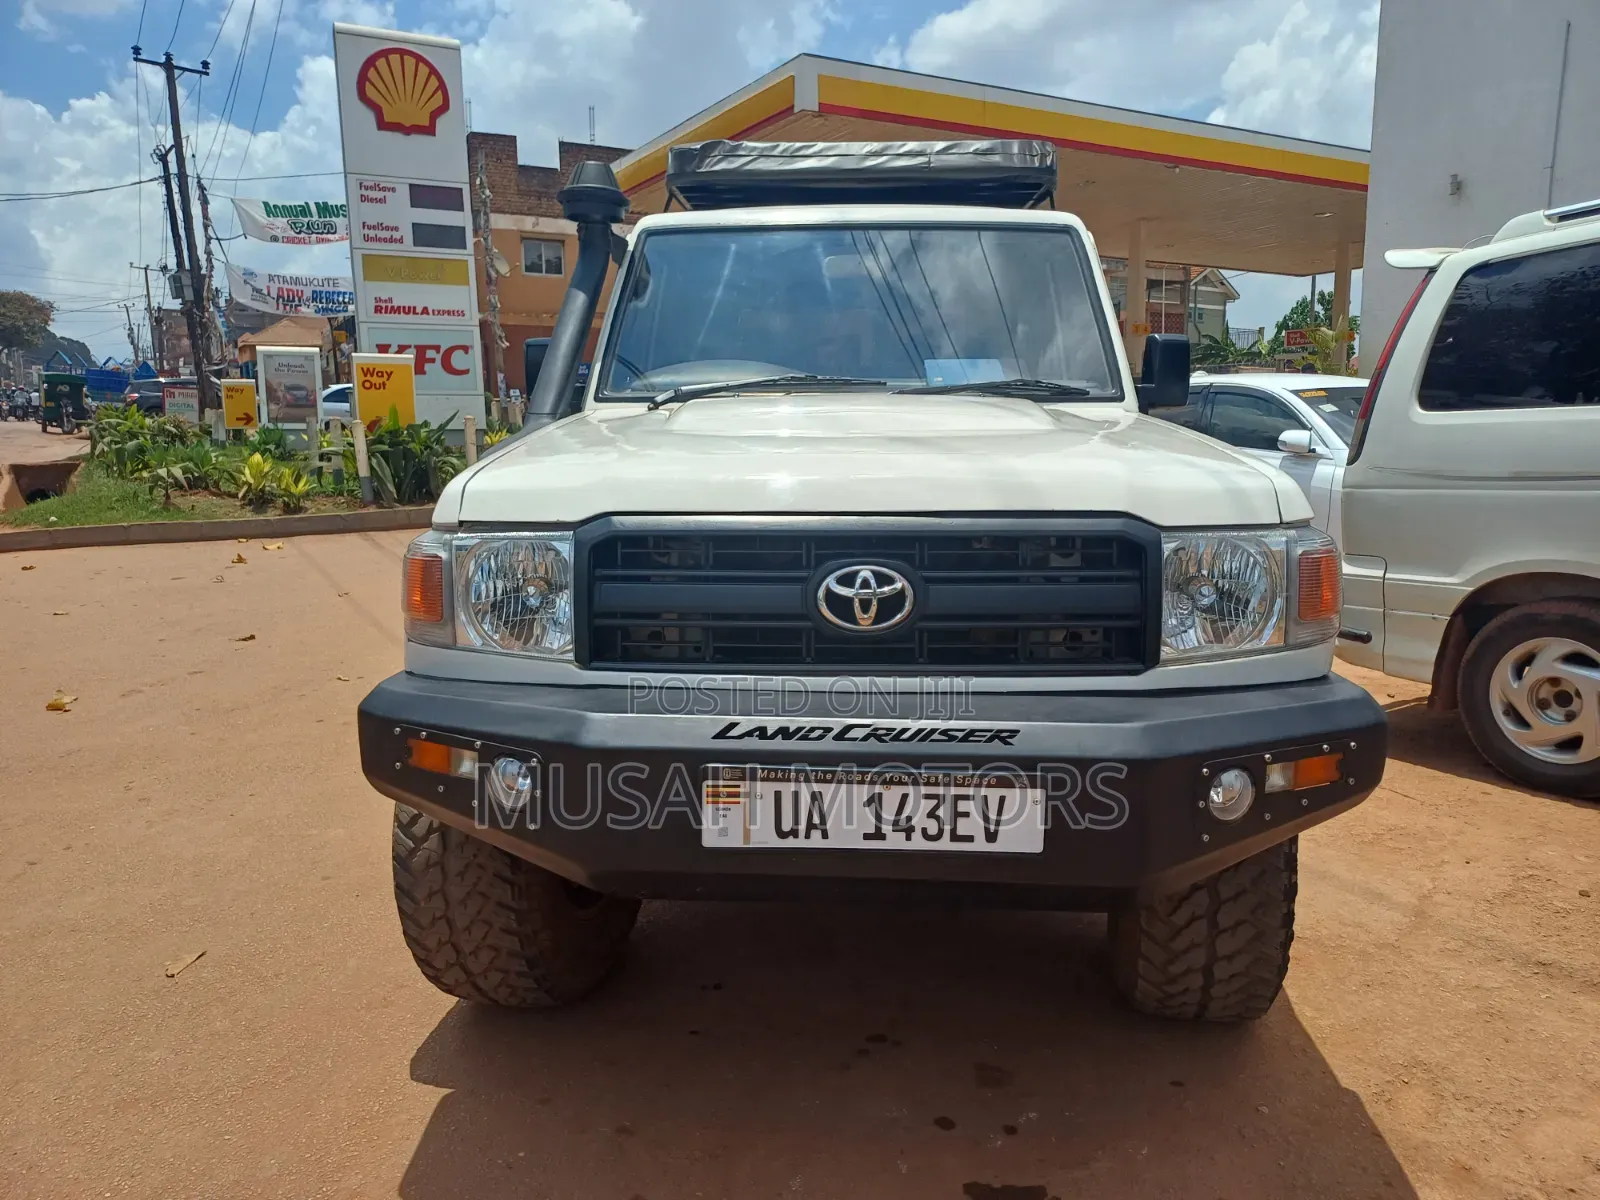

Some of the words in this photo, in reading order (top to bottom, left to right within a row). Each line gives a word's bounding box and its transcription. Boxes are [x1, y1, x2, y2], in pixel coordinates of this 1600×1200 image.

[359, 182, 396, 193] FuelSave
[360, 194, 387, 204] Diesel
[262, 201, 313, 218] Annual
[362, 222, 399, 232] FuelSave
[282, 235, 312, 245] CRICKET
[363, 233, 404, 244] Unleaded
[268, 274, 340, 288] ATAMUKUTE
[266, 285, 304, 304] LADY
[374, 304, 430, 316] RIMULA
[432, 309, 465, 317] EXPRESS
[1290, 337, 1310, 345] V-Pow
[361, 367, 394, 381] Way
[226, 386, 245, 395] Way
[362, 380, 387, 390] Out
[711, 722, 834, 742] LAND
[832, 723, 1021, 747] CRUISER
[757, 769, 805, 781] Making
[811, 770, 832, 780] the
[839, 771, 879, 782] Roads
[885, 773, 915, 783] Your
[920, 774, 950, 784] Safe
[956, 775, 997, 787] Space
[774, 790, 829, 840] UA
[862, 791, 1007, 844] 143EV
